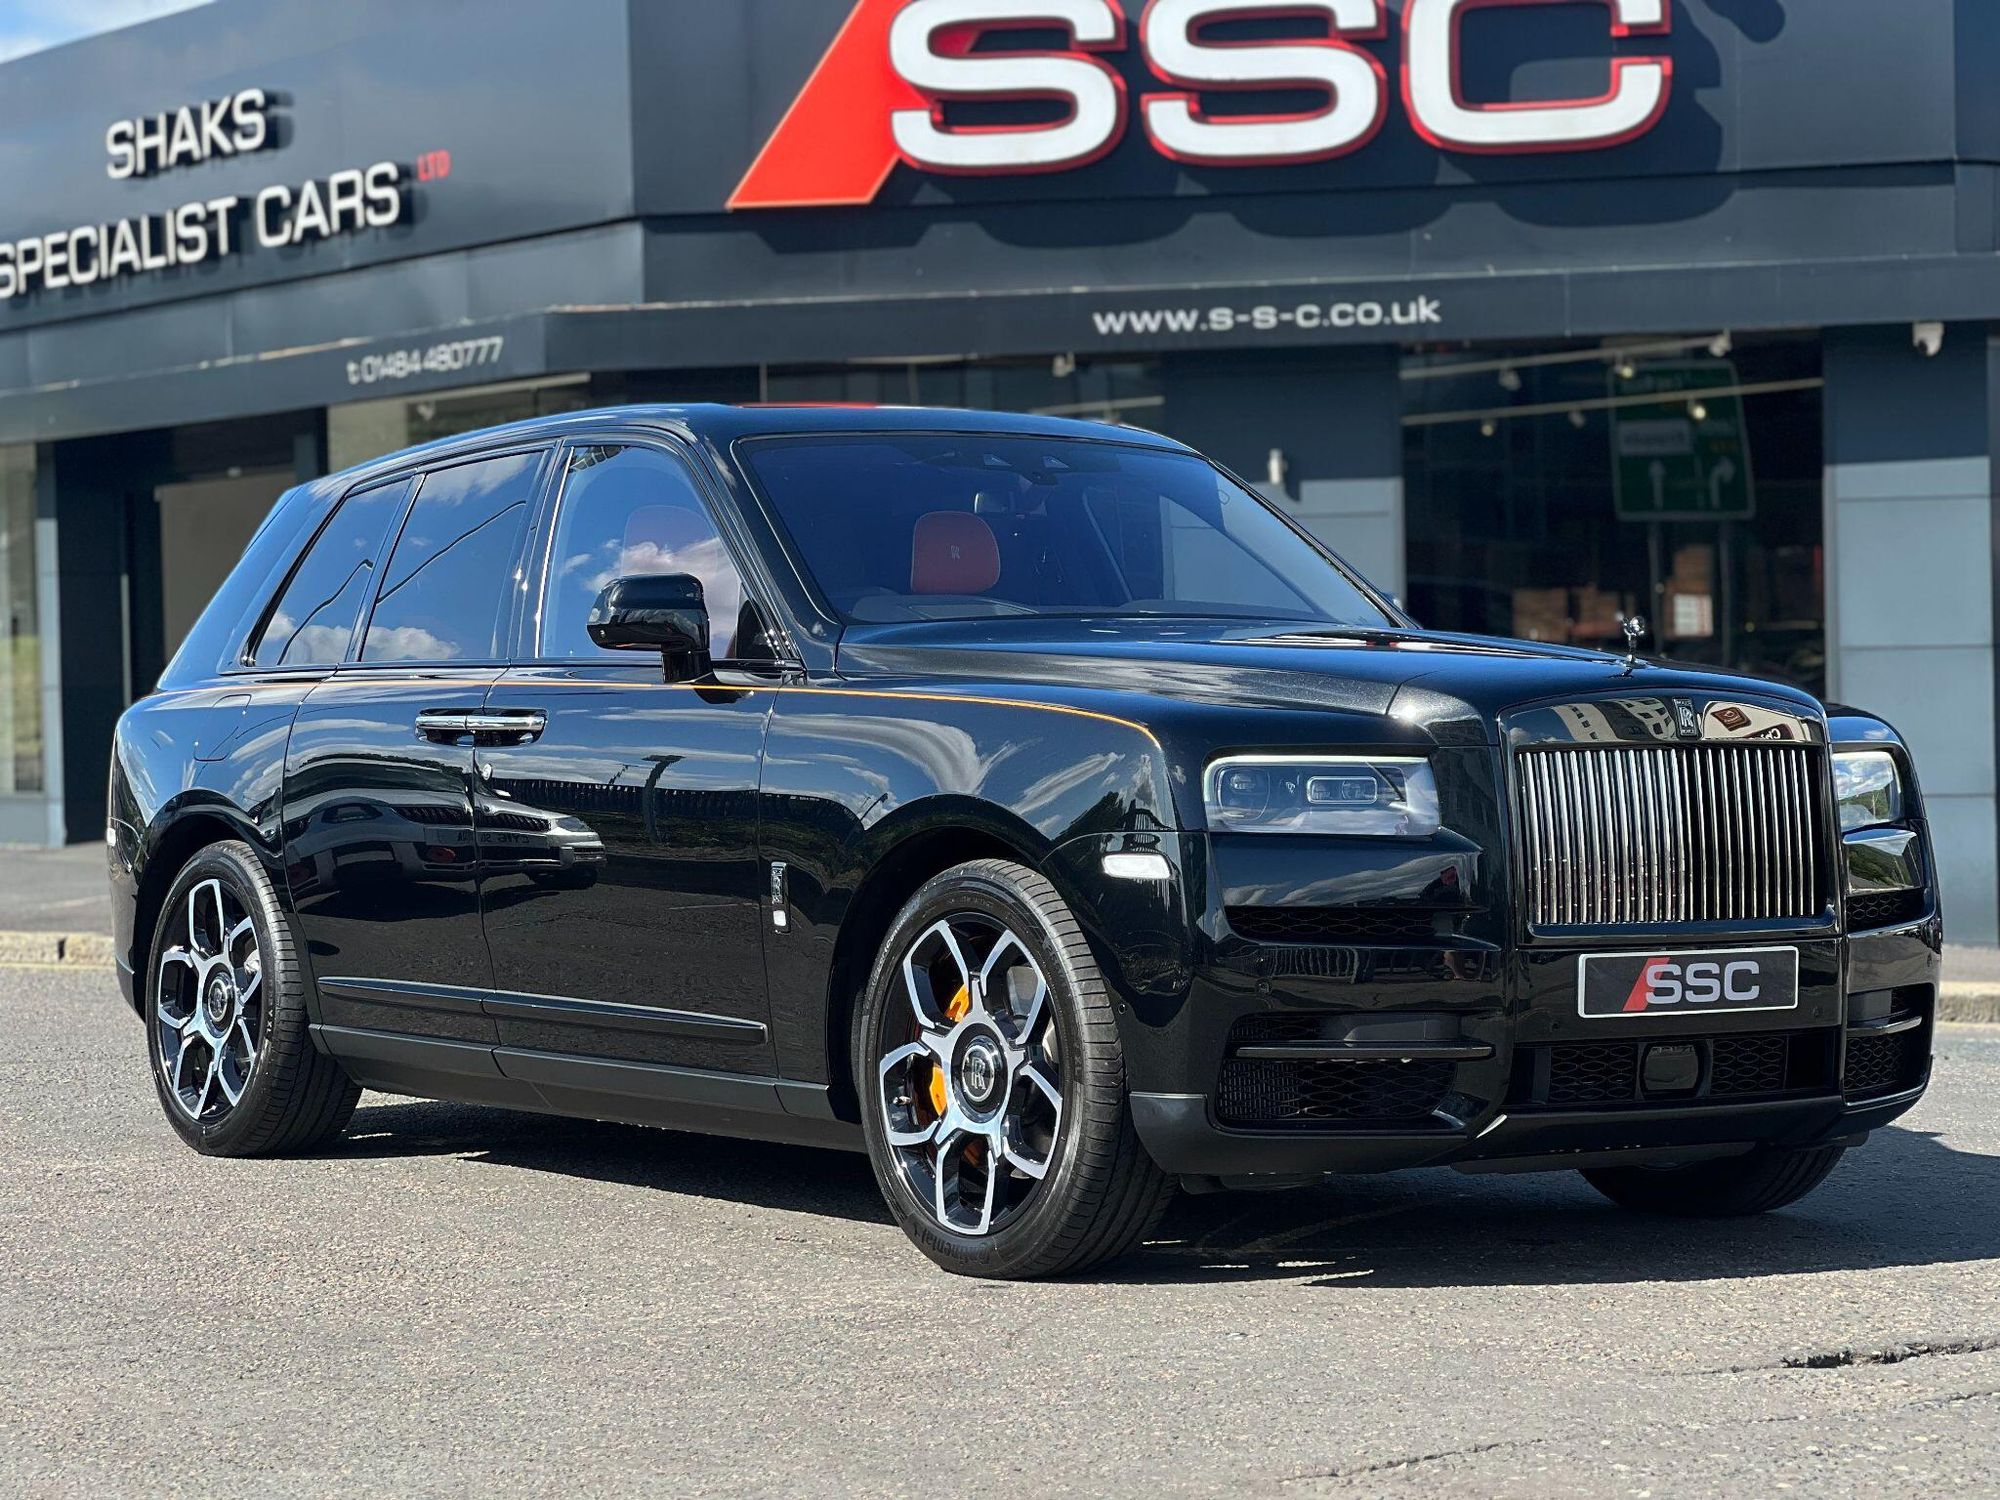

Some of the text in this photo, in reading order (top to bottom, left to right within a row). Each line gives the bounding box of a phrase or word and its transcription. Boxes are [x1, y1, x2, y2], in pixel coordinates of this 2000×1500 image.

[890, 0, 1672, 174] SSC
[106, 89, 266, 179] SHAKS
[0, 149, 451, 299] SPECIALIST CARS LTD
[1093, 295, 1441, 335] www.s-s-c.co.uk
[1645, 960, 1760, 1005] SSC
